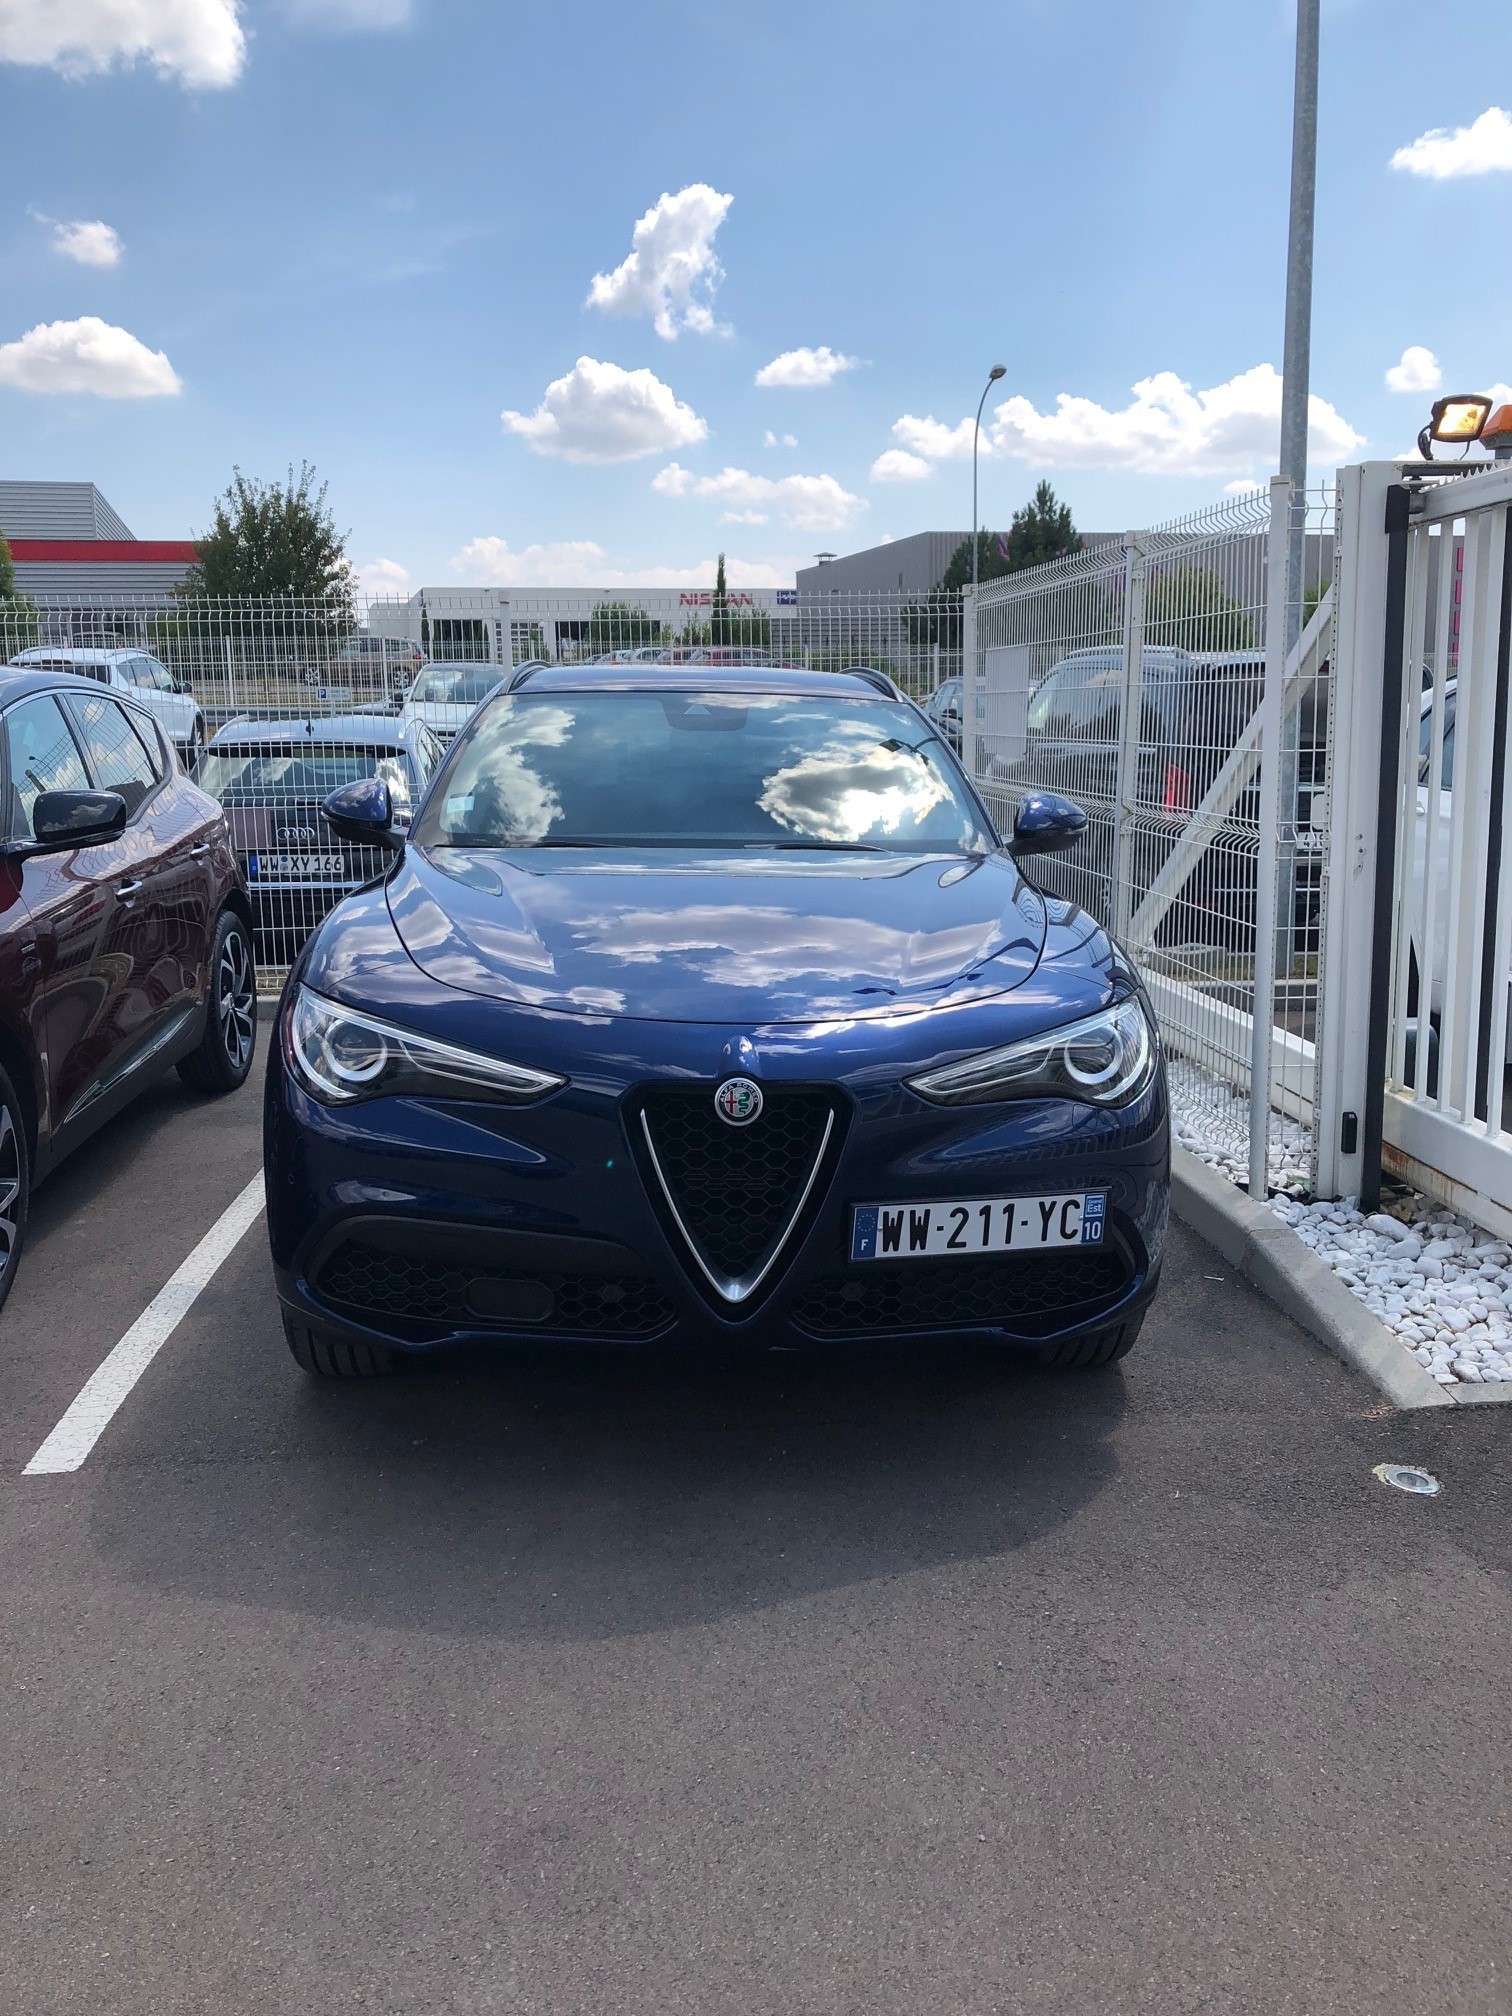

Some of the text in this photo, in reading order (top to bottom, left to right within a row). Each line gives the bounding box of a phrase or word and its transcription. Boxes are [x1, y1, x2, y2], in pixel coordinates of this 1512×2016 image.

[680, 592, 752, 606] NISAN
[1087, 1203, 1102, 1213] Est
[882, 1200, 1080, 1252] WW-211-YC
[1084, 1221, 1102, 1240] 10
[861, 1239, 869, 1251] F
